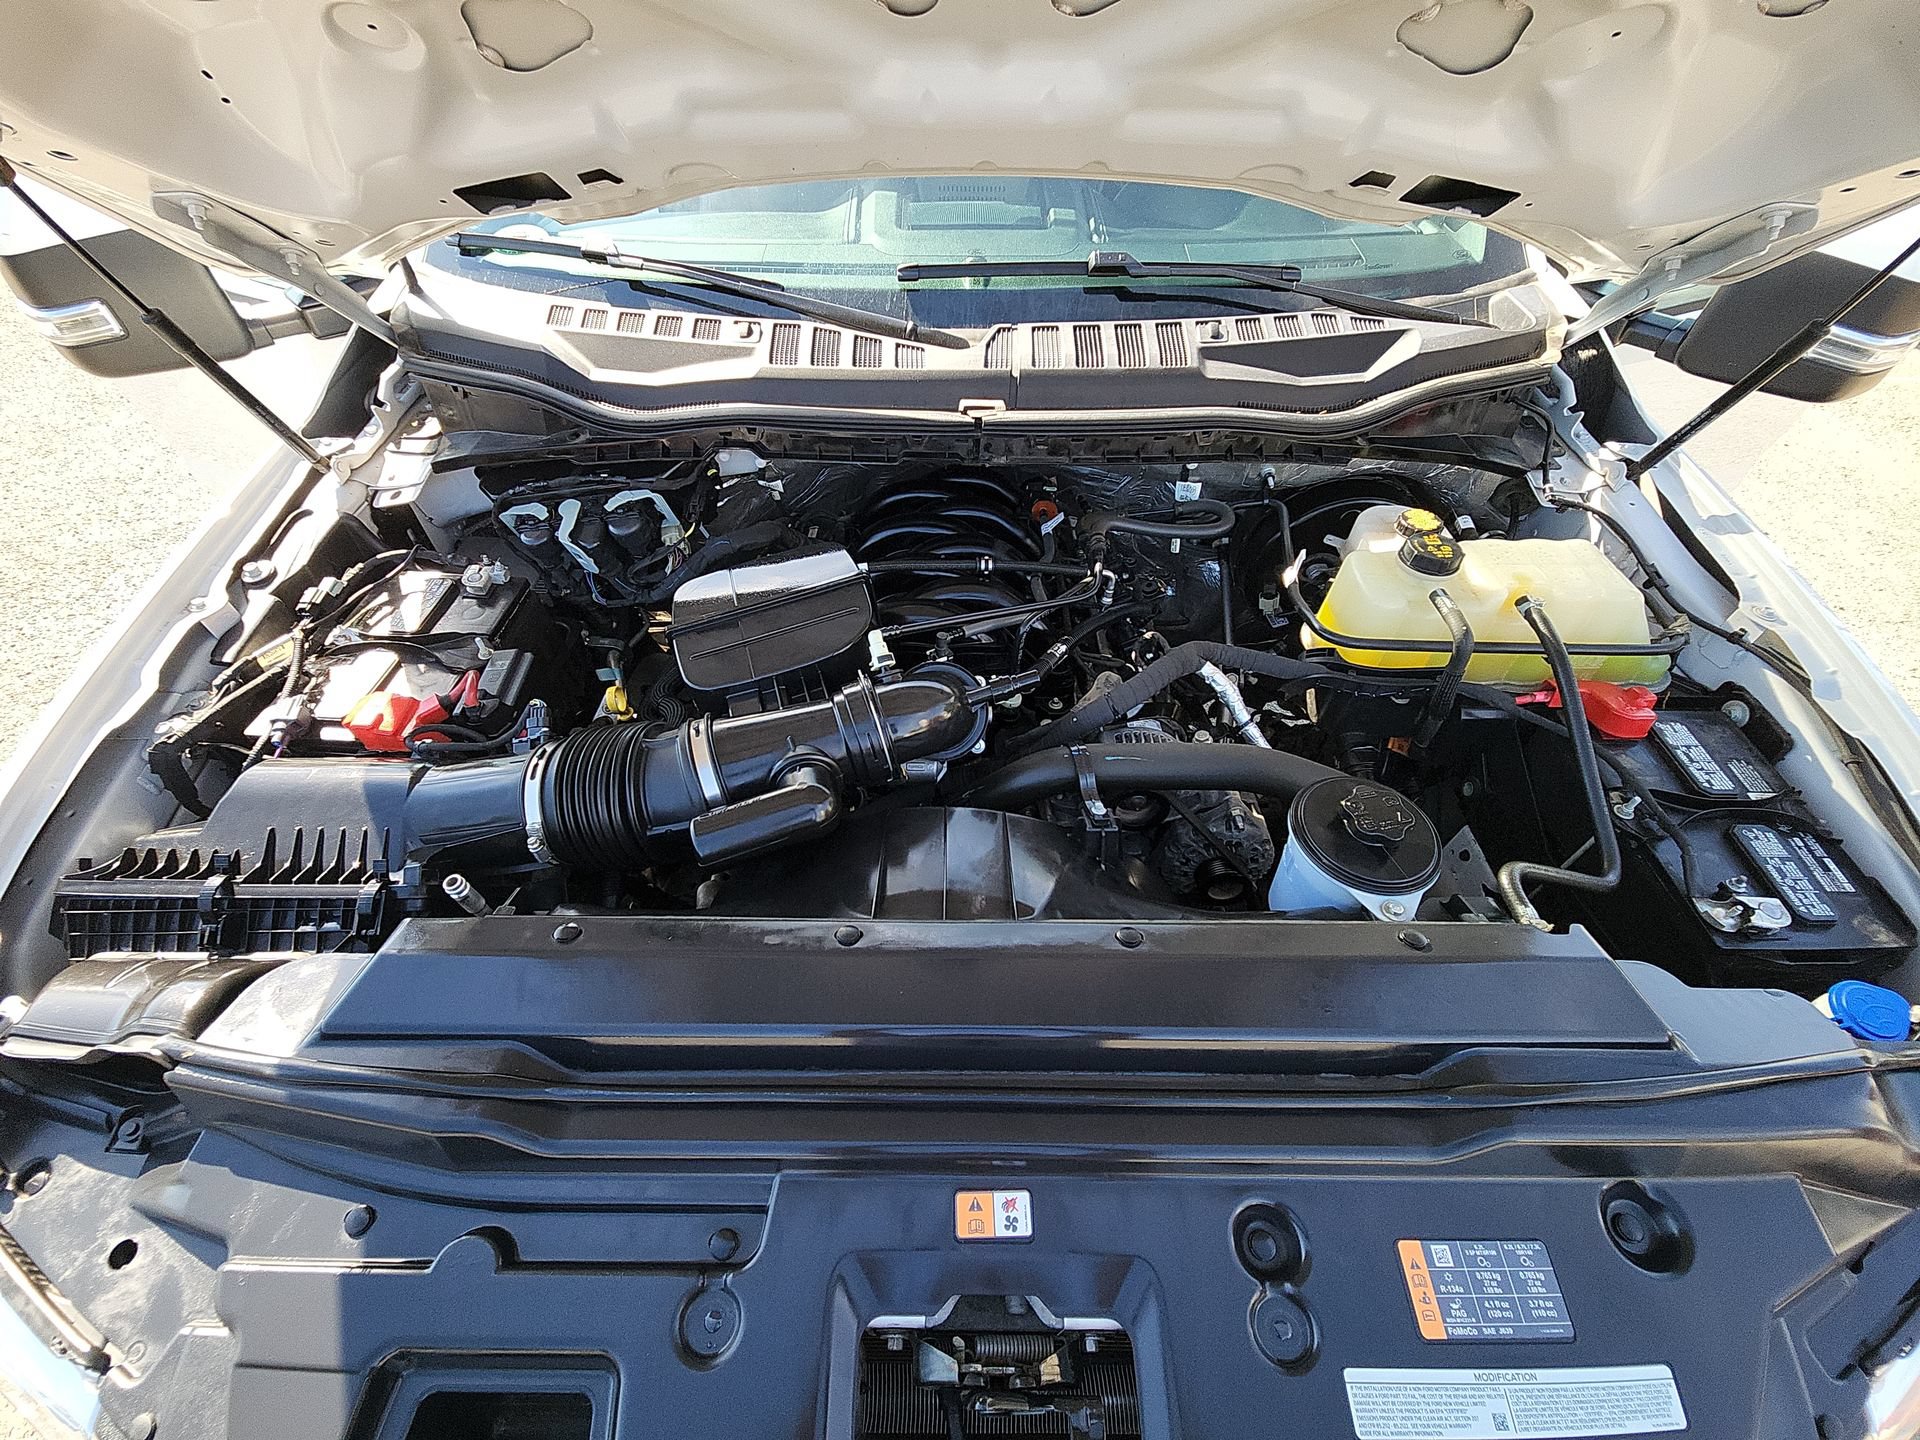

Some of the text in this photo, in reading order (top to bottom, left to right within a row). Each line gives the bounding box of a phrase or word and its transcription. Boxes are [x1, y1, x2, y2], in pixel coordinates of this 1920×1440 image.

[1490, 1272, 1501, 1281] kg
[1534, 1272, 1545, 1280] kg
[1440, 1285, 1464, 1293] R-134a
[1487, 1310, 1514, 1318] (120 cc)
[1531, 1310, 1558, 1318] (110 cc)
[1448, 1327, 1478, 1335] FoMoCo
[1473, 1372, 1538, 1382] MODIFICATION
